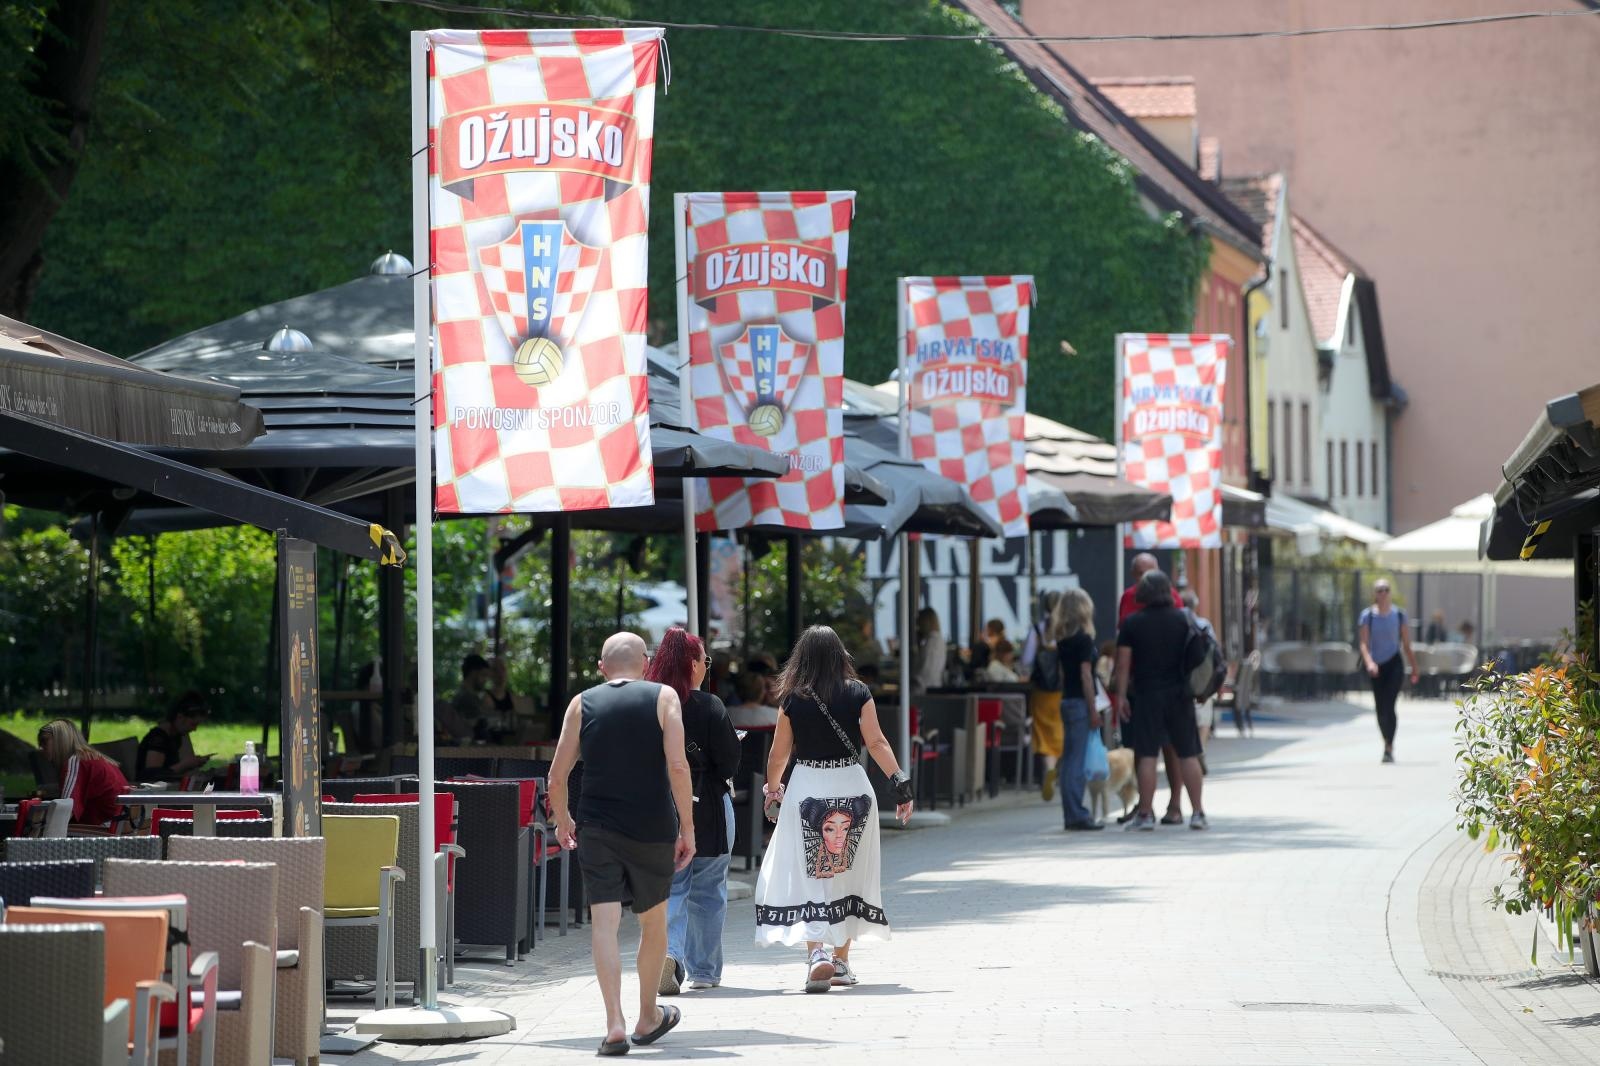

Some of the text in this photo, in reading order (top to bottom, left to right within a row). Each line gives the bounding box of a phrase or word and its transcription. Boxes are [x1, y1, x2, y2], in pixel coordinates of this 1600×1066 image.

[457, 108, 623, 170] Ožujsko
[531, 234, 552, 321] HNS
[705, 245, 826, 291] Ožujsko
[916, 337, 1015, 363] HRVATSKA
[922, 366, 1009, 400] Ožujsko
[454, 402, 622, 431] PONOSNI SPONZOR
